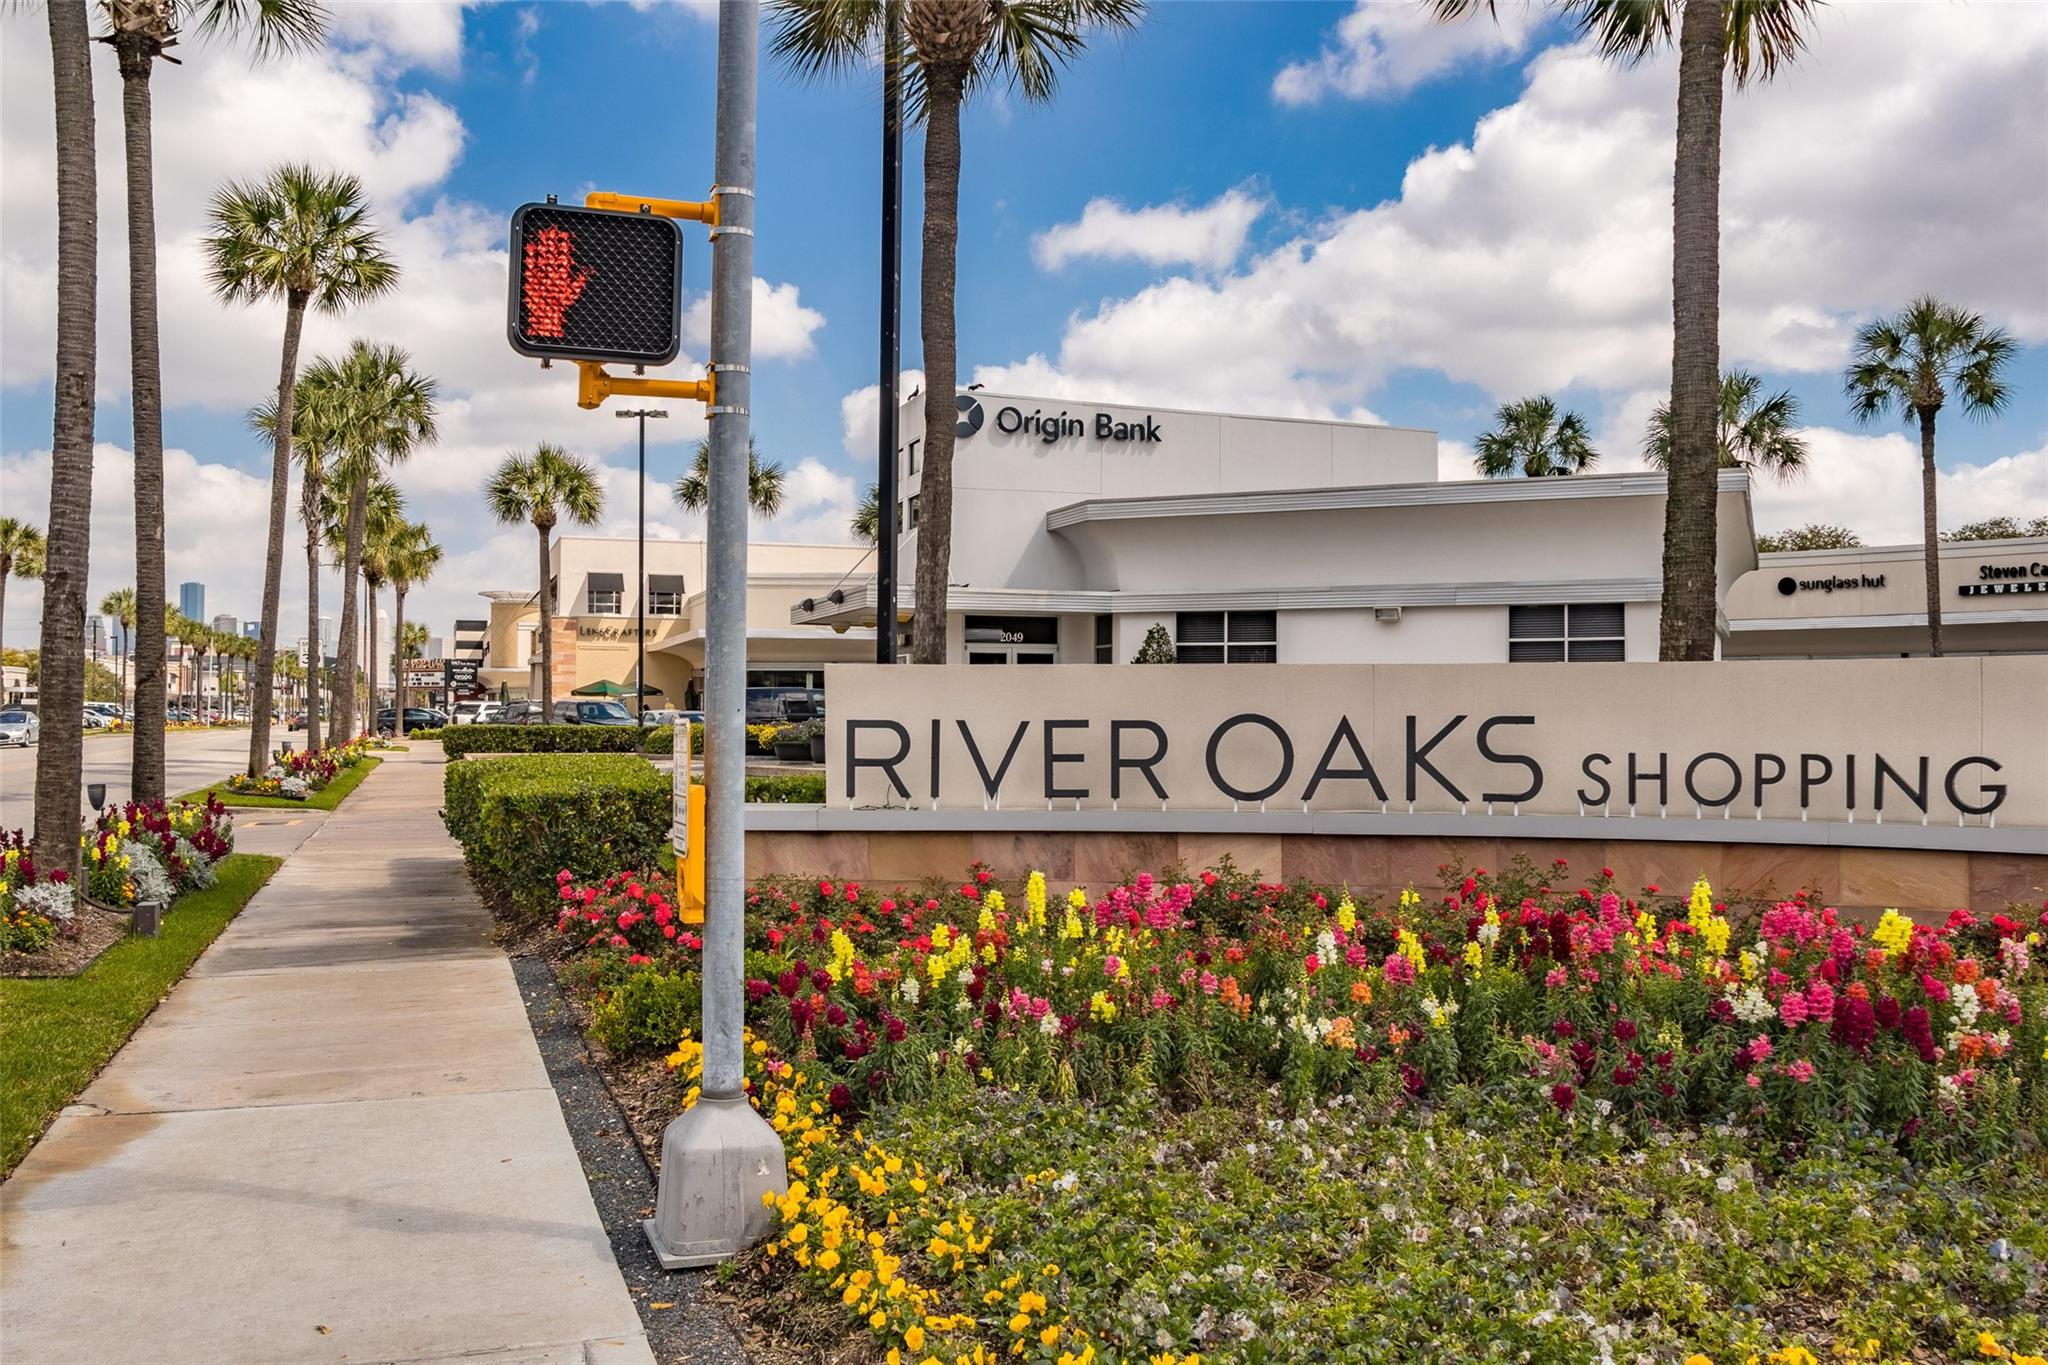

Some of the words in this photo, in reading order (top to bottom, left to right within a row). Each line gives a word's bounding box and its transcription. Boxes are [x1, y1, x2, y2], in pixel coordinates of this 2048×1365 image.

[997, 406, 1084, 444] Origin
[1095, 413, 1162, 442] Bank
[1979, 565, 2027, 580] Steven
[1799, 575, 1859, 593] sunglass
[1861, 574, 1886, 588] hut
[1000, 631, 1024, 643] 2049
[302, 653, 321, 664] 3
[846, 719, 1169, 799] RIVER
[1205, 713, 1544, 802] OAKS
[1577, 752, 2007, 815] SHOPPING
